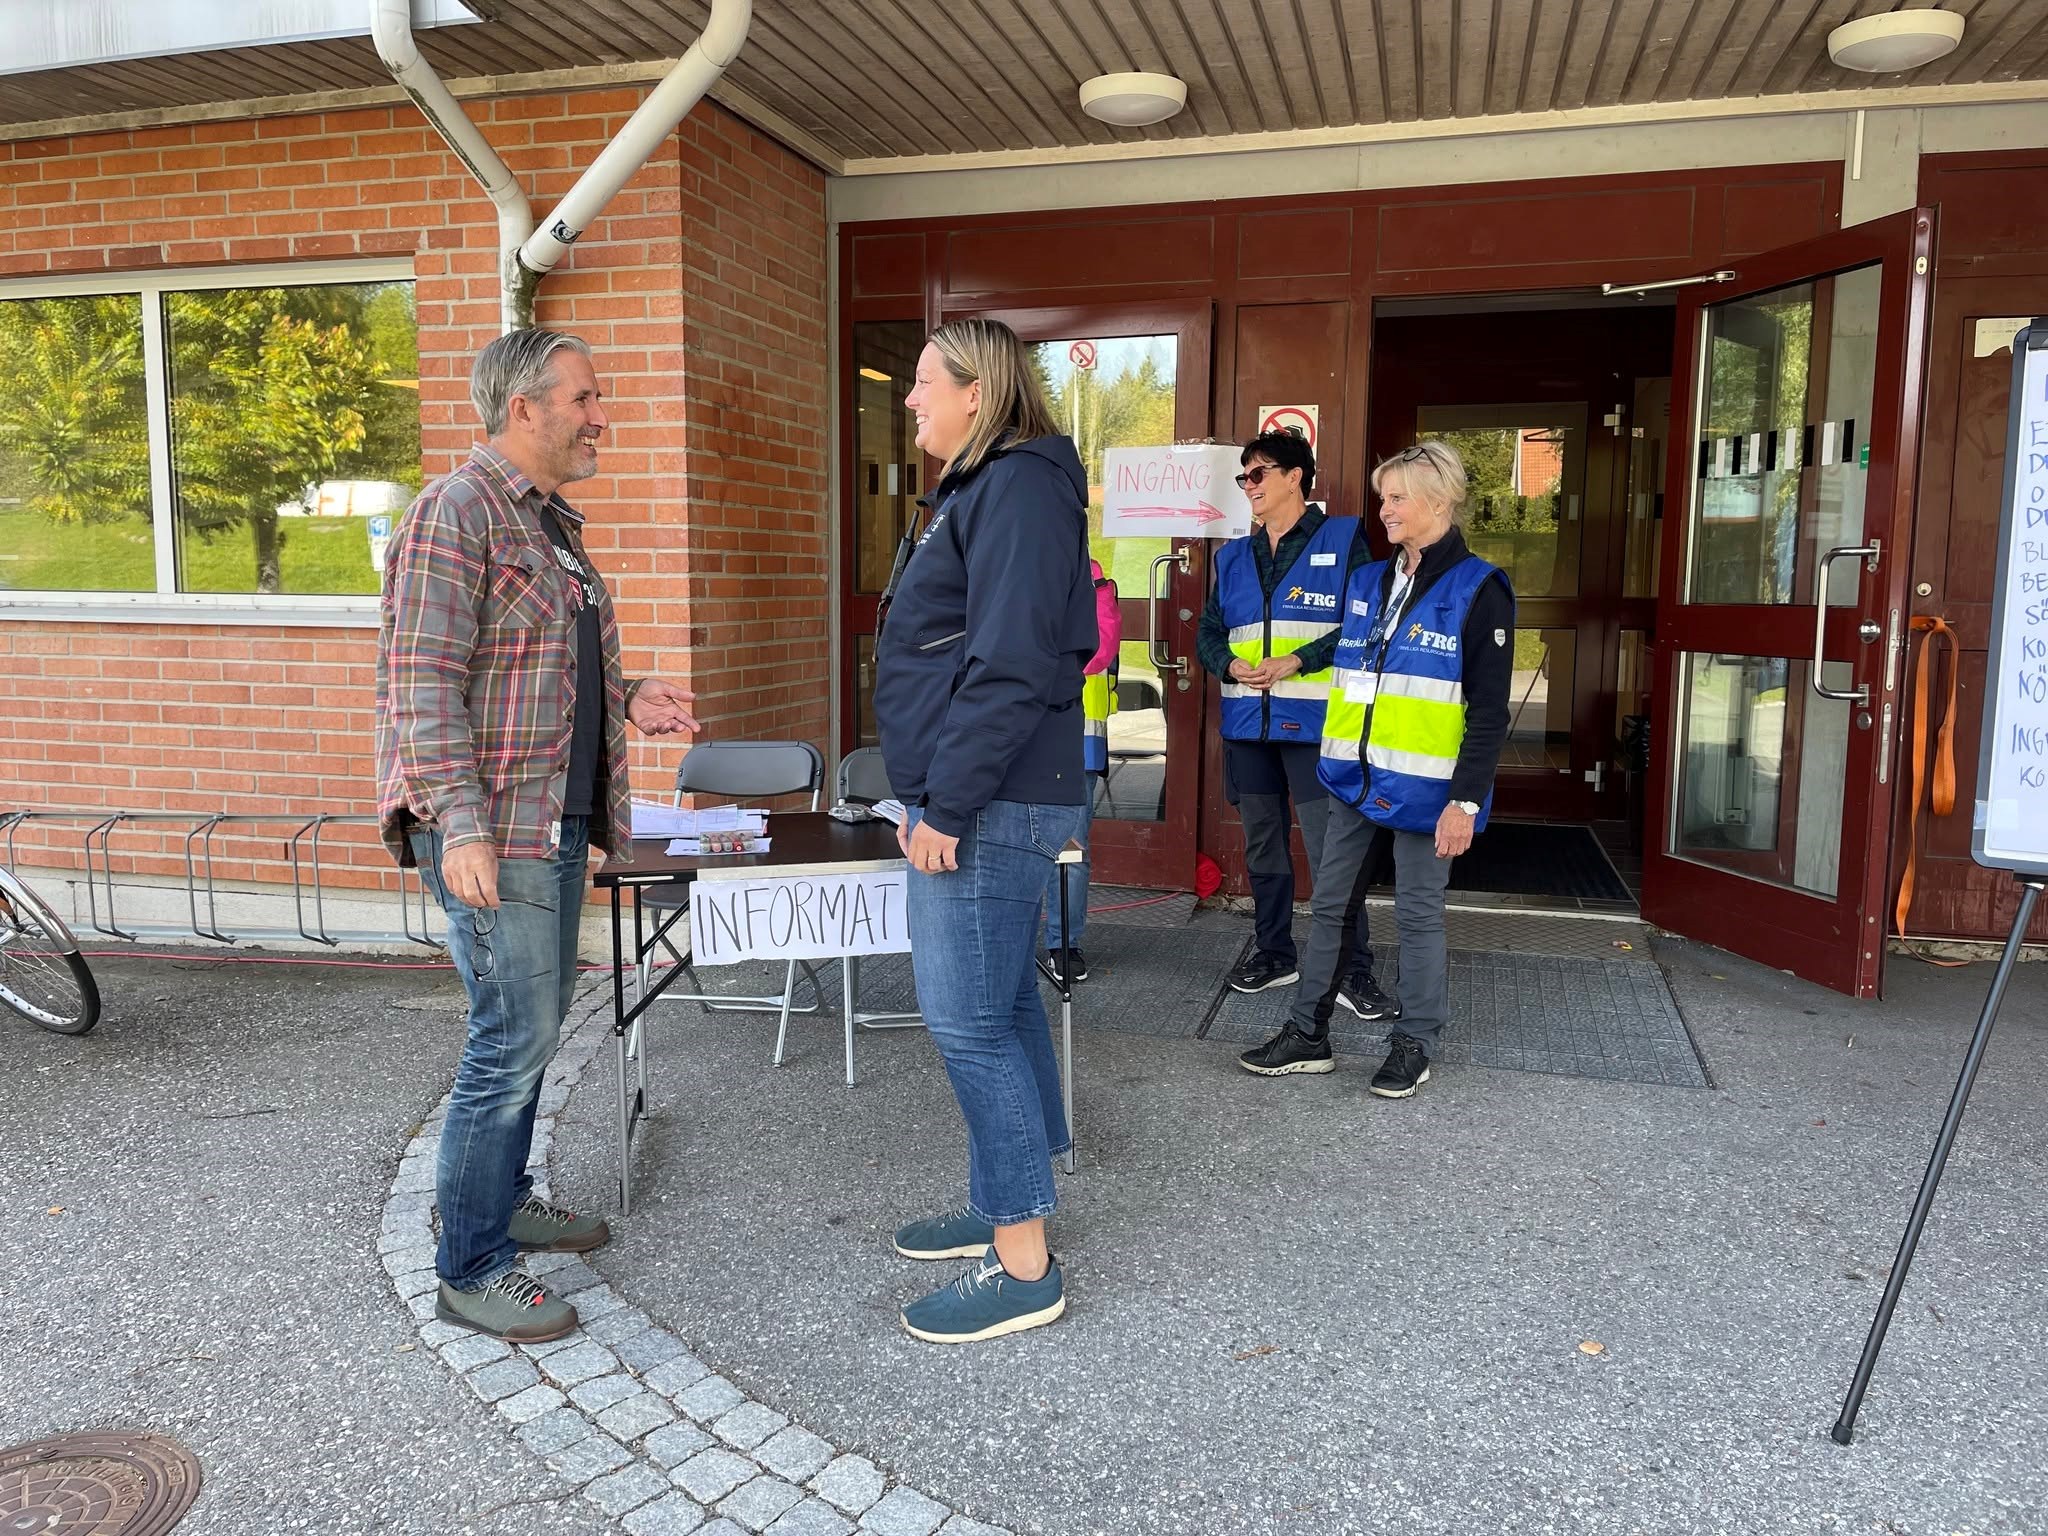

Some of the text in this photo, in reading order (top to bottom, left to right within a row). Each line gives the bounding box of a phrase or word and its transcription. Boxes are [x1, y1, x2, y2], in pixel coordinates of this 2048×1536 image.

[1117, 453, 1211, 493] INGÅNG
[1303, 592, 1336, 608] FRG
[1420, 630, 1457, 651] FRG
[2012, 723, 2048, 756] ING
